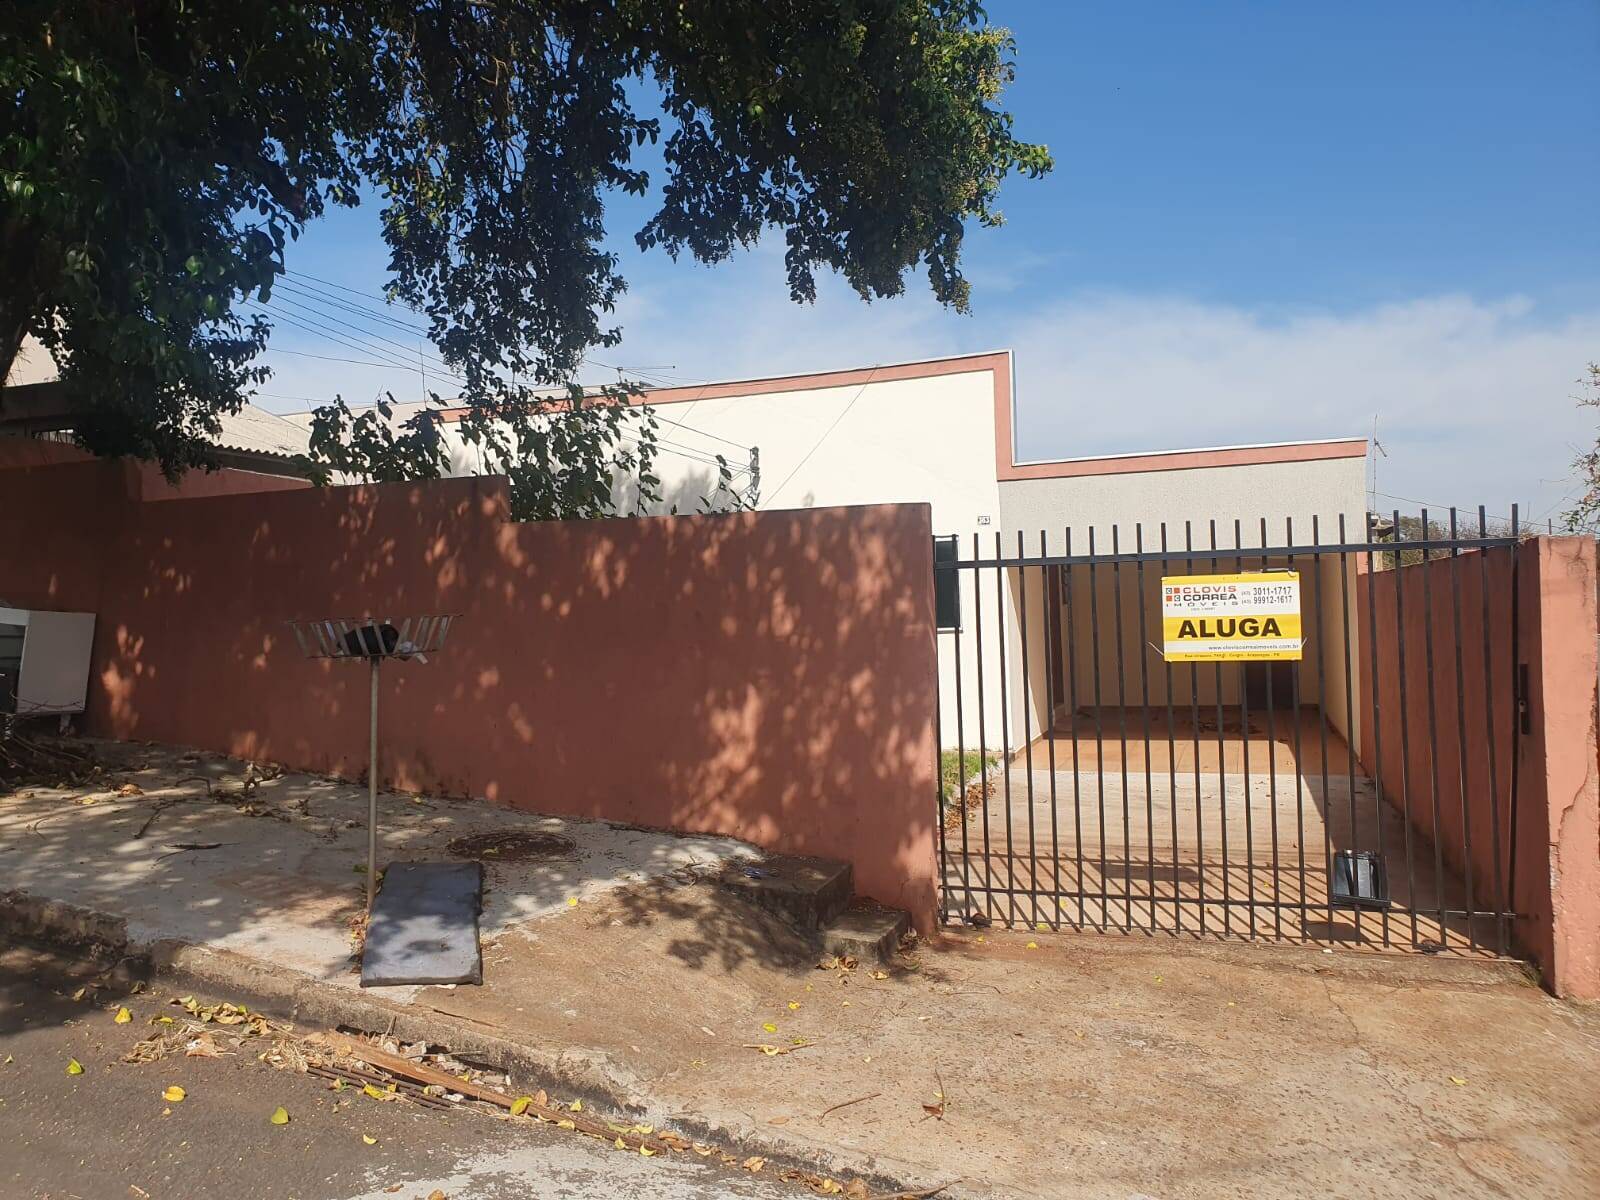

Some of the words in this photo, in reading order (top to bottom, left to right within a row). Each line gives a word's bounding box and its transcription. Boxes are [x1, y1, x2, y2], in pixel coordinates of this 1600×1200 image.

[1253, 586, 1292, 596] 3011-1717
[1183, 593, 1237, 601] CORREA
[1253, 595, 1293, 604] 99912-1617
[1178, 618, 1282, 639] ALUGA
